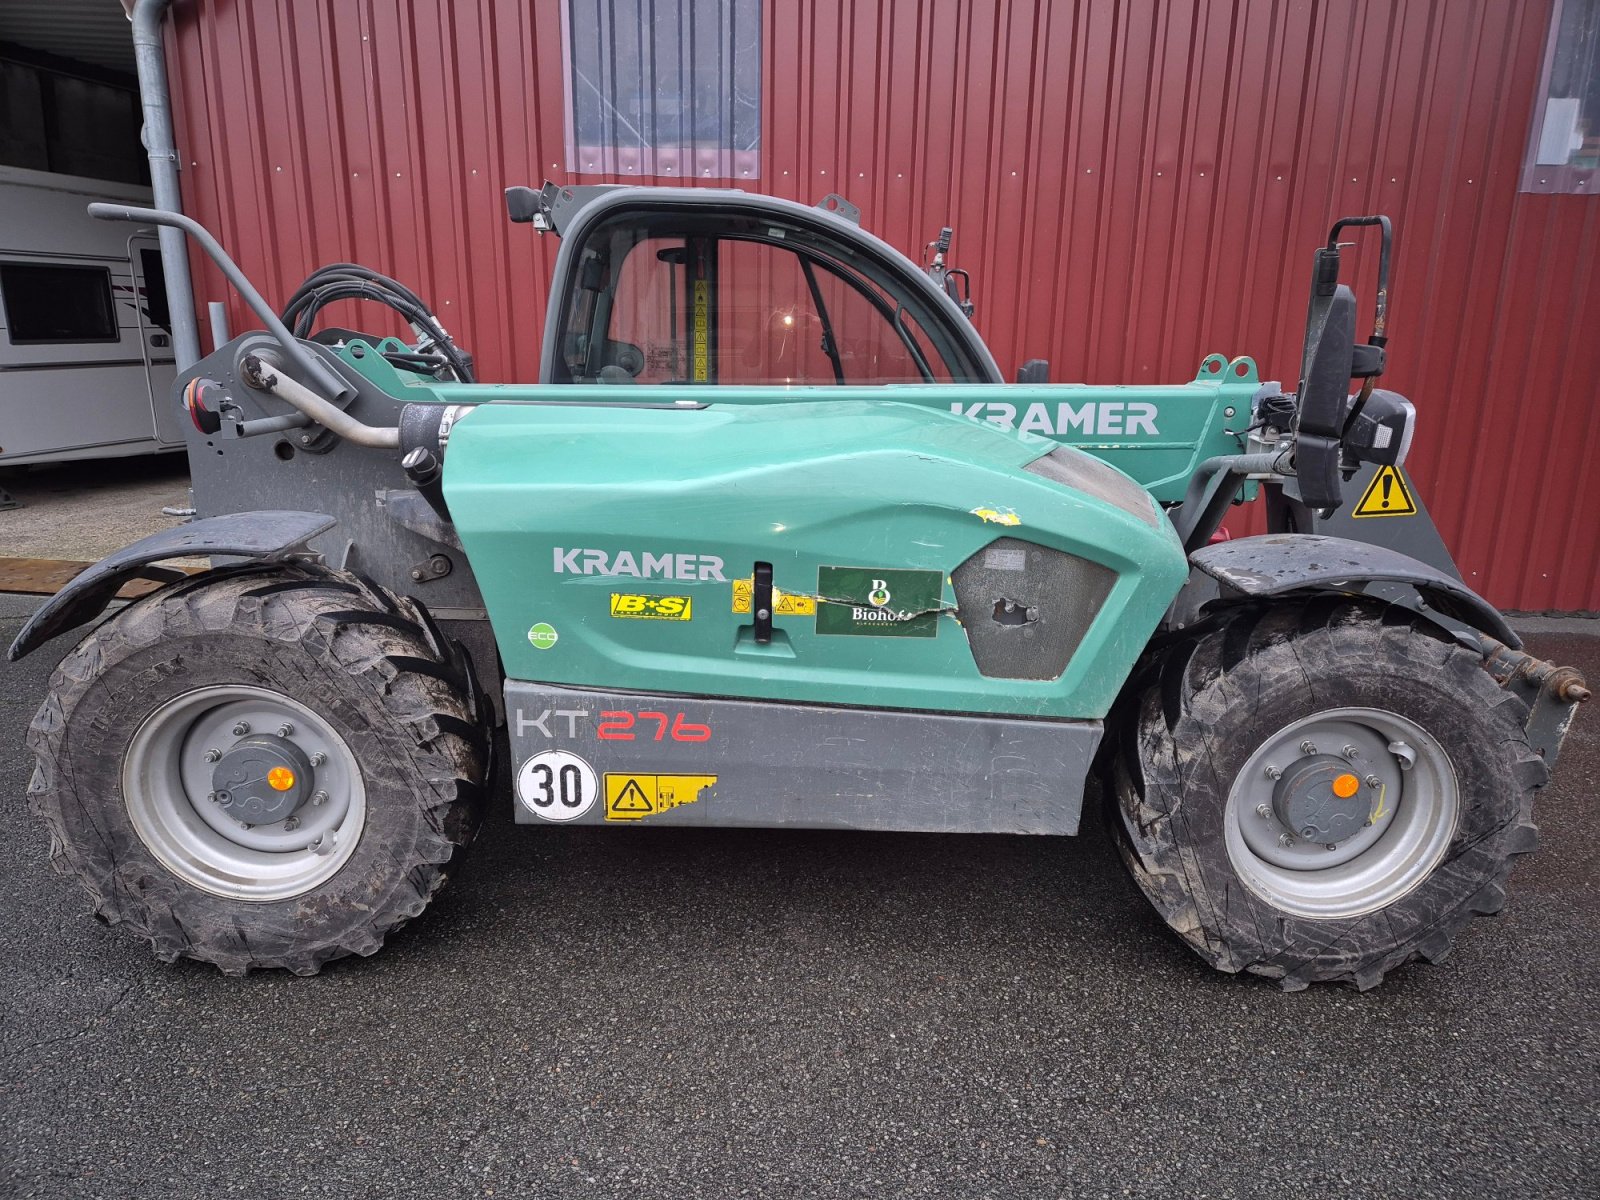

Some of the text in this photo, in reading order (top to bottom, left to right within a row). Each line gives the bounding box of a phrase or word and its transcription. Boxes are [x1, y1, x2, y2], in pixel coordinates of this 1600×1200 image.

[951, 402, 1160, 435] KRAMER
[553, 547, 727, 582] KRAMER
[615, 595, 685, 614] B+S
[528, 631, 558, 641] ECO
[516, 708, 712, 742] KT 276
[531, 763, 583, 808] 30
